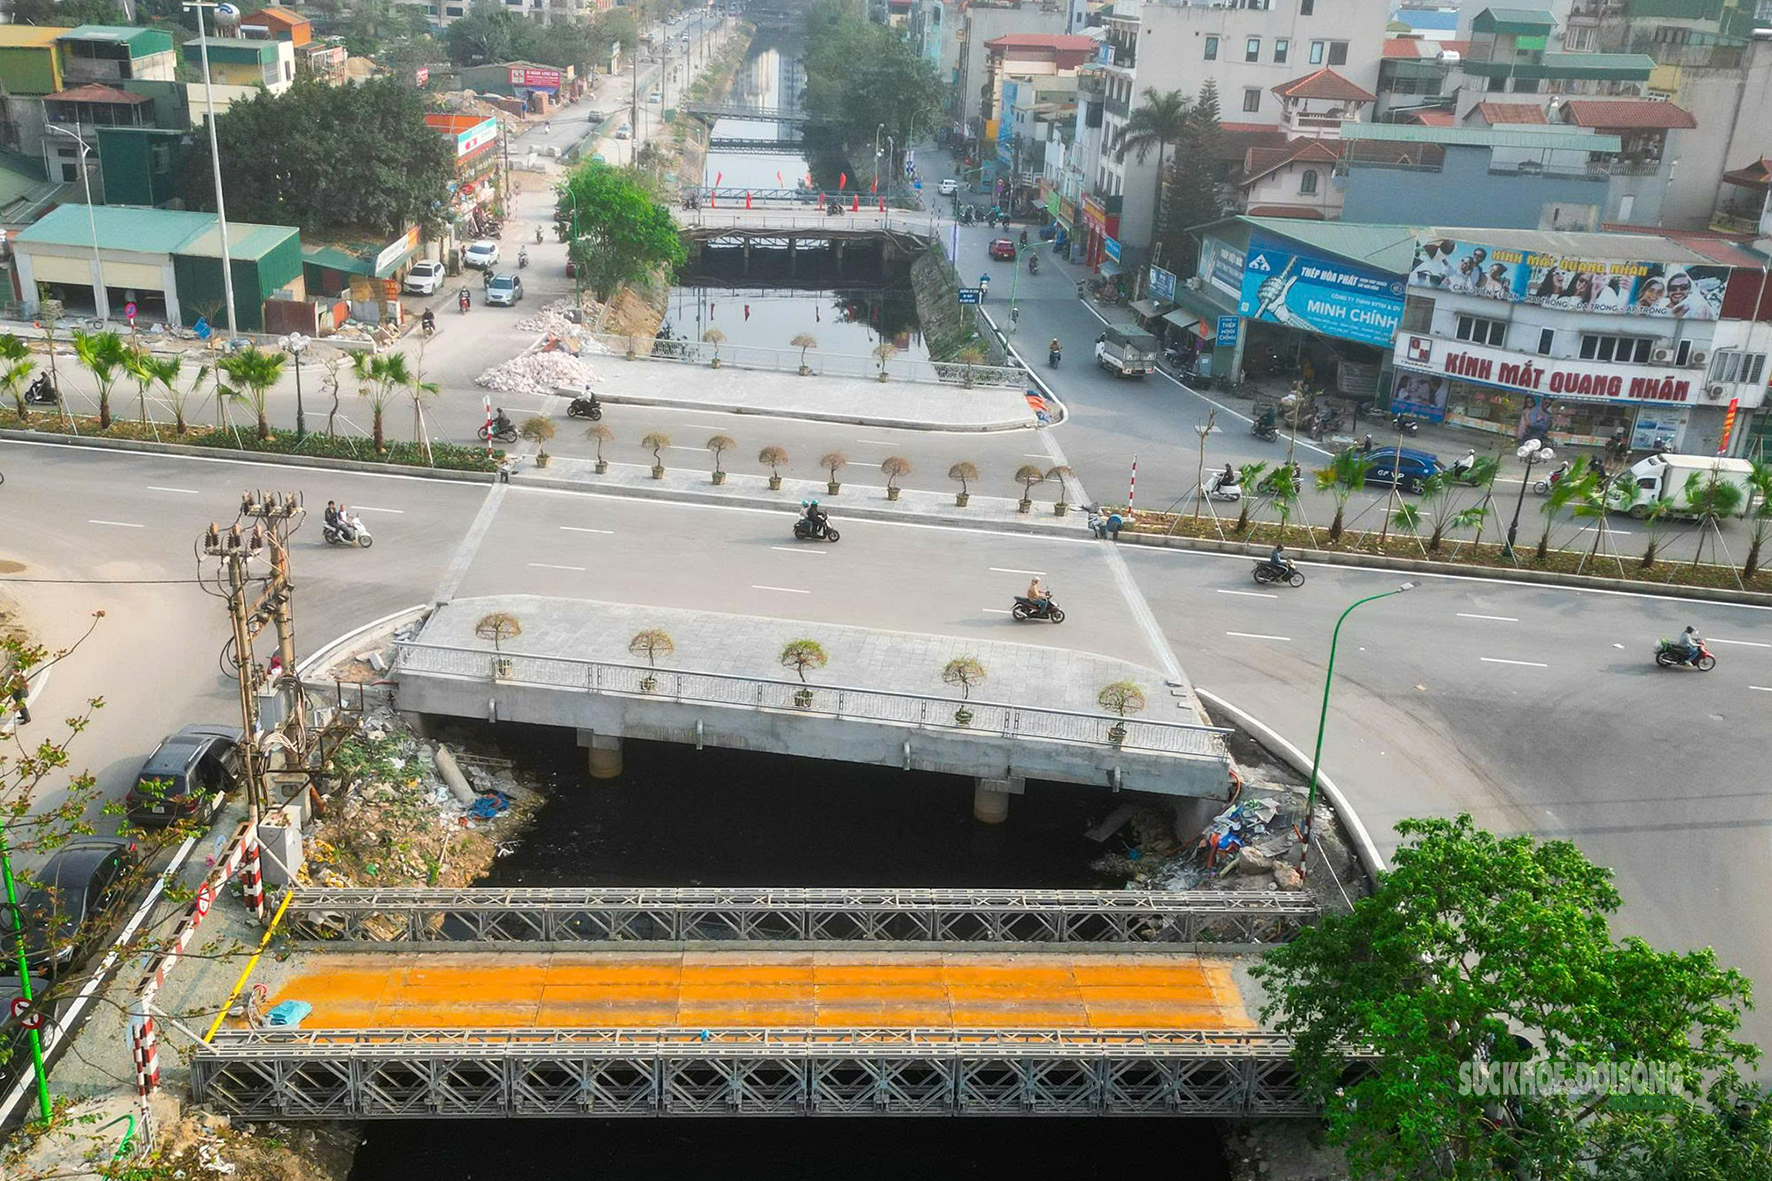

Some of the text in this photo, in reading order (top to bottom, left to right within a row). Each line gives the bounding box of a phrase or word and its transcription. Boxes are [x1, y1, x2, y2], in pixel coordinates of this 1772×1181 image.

[1301, 266, 1321, 280] THÉP
[1320, 270, 1337, 283] HÒA
[1337, 274, 1360, 287] PHÁT
[1307, 299, 1346, 319] MINH
[1350, 308, 1398, 329] CHÍNH
[1445, 351, 1493, 380] KÍNH
[1498, 360, 1545, 390] MẮT
[1549, 371, 1623, 397] QUANG
